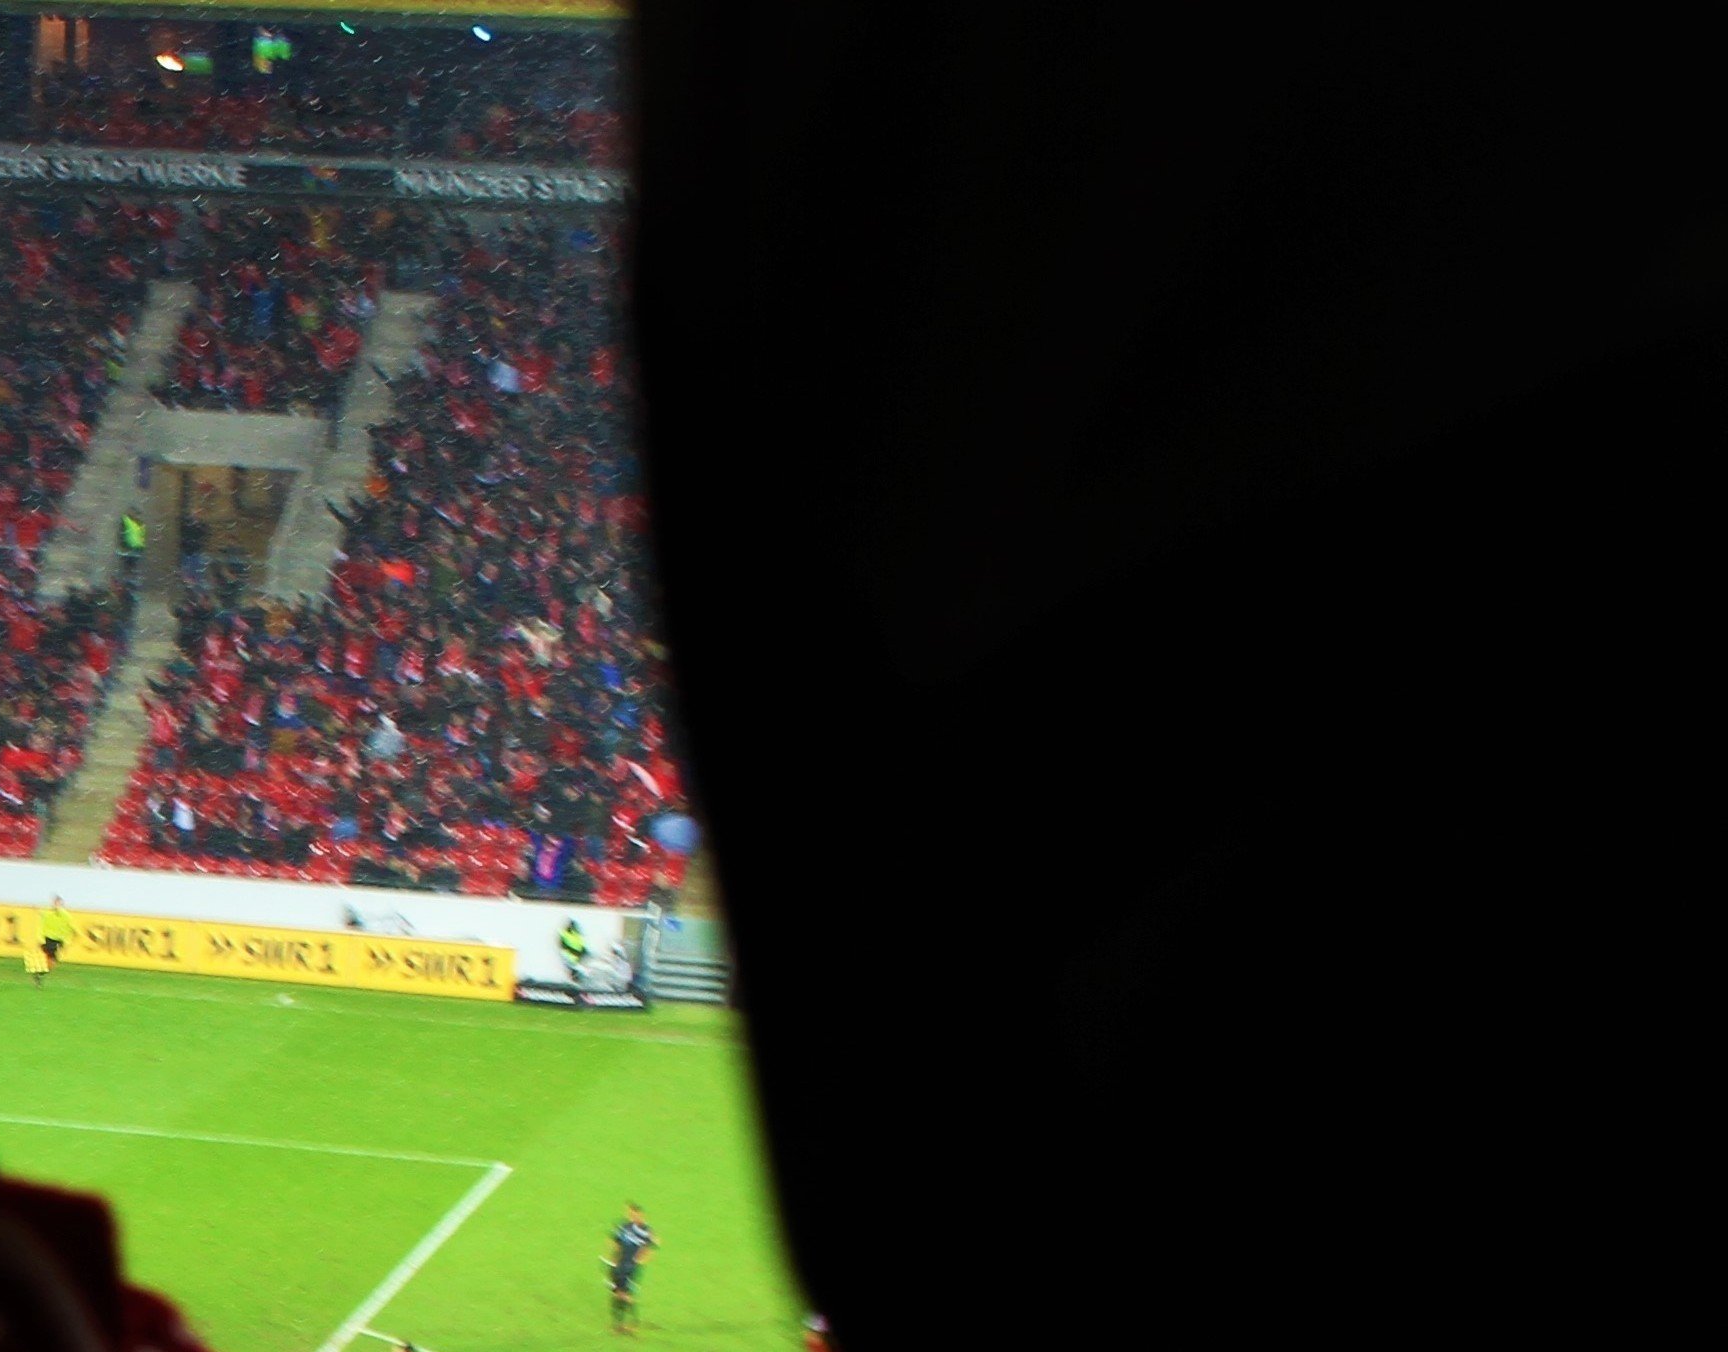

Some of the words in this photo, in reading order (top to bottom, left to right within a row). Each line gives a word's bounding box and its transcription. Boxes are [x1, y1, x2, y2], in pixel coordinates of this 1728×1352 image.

[85, 922, 179, 962] SWR1
[242, 935, 338, 976] SWR1
[403, 949, 504, 990] SWR1
